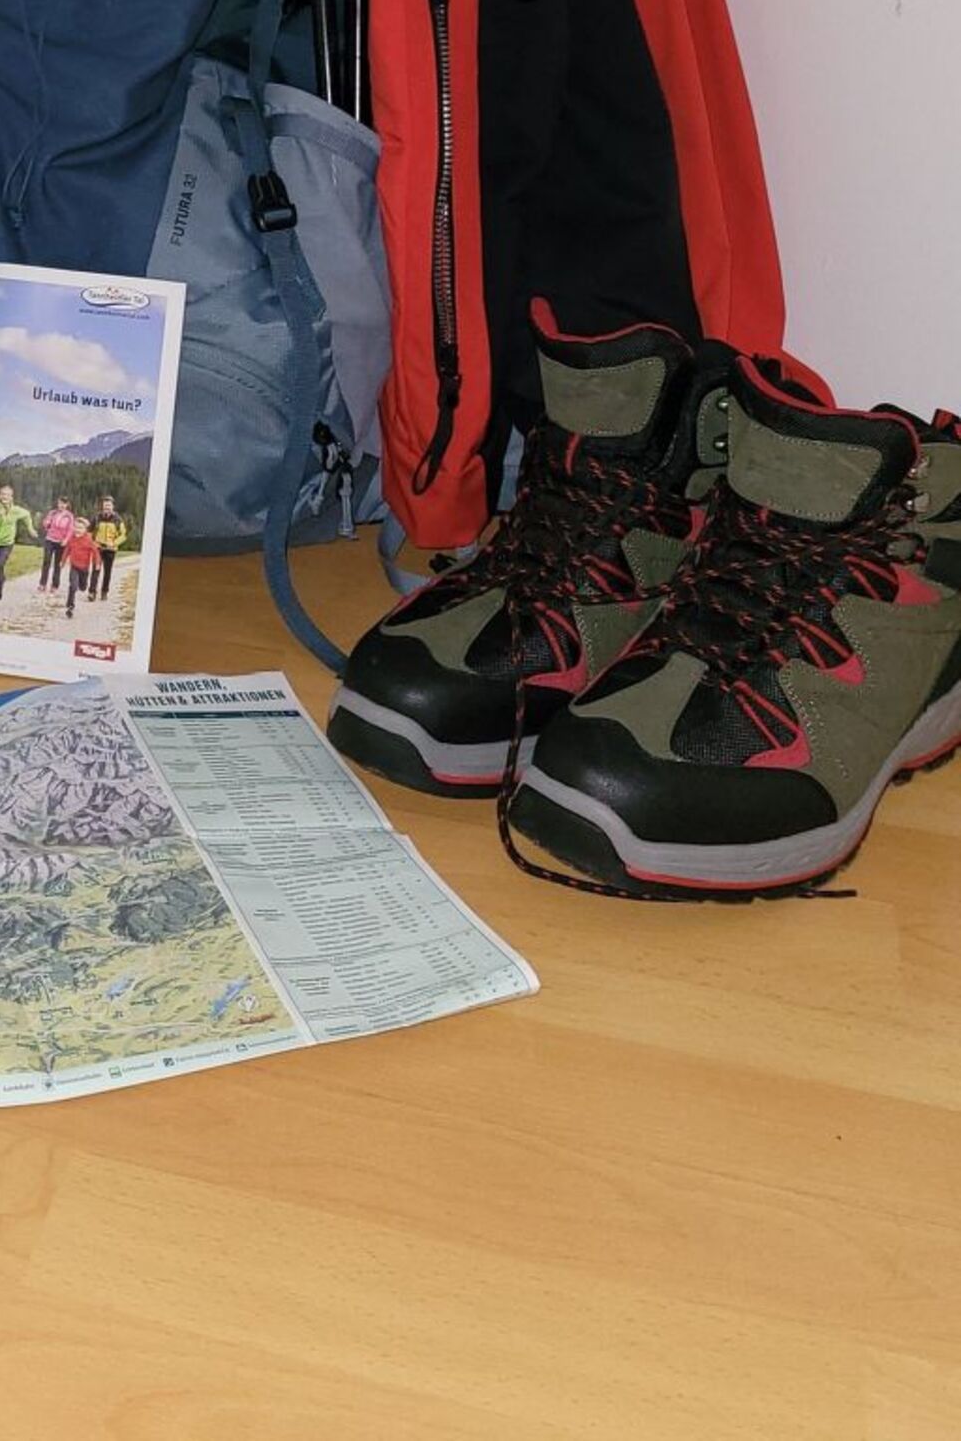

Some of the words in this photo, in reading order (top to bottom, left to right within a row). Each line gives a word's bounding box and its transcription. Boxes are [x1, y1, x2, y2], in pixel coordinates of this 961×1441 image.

[170, 192, 193, 247] FUTURA
[33, 386, 78, 404] Urlaub
[81, 396, 108, 408] was
[111, 397, 142, 411] tun?
[192, 689, 287, 706] ATTRAKTIONEN
